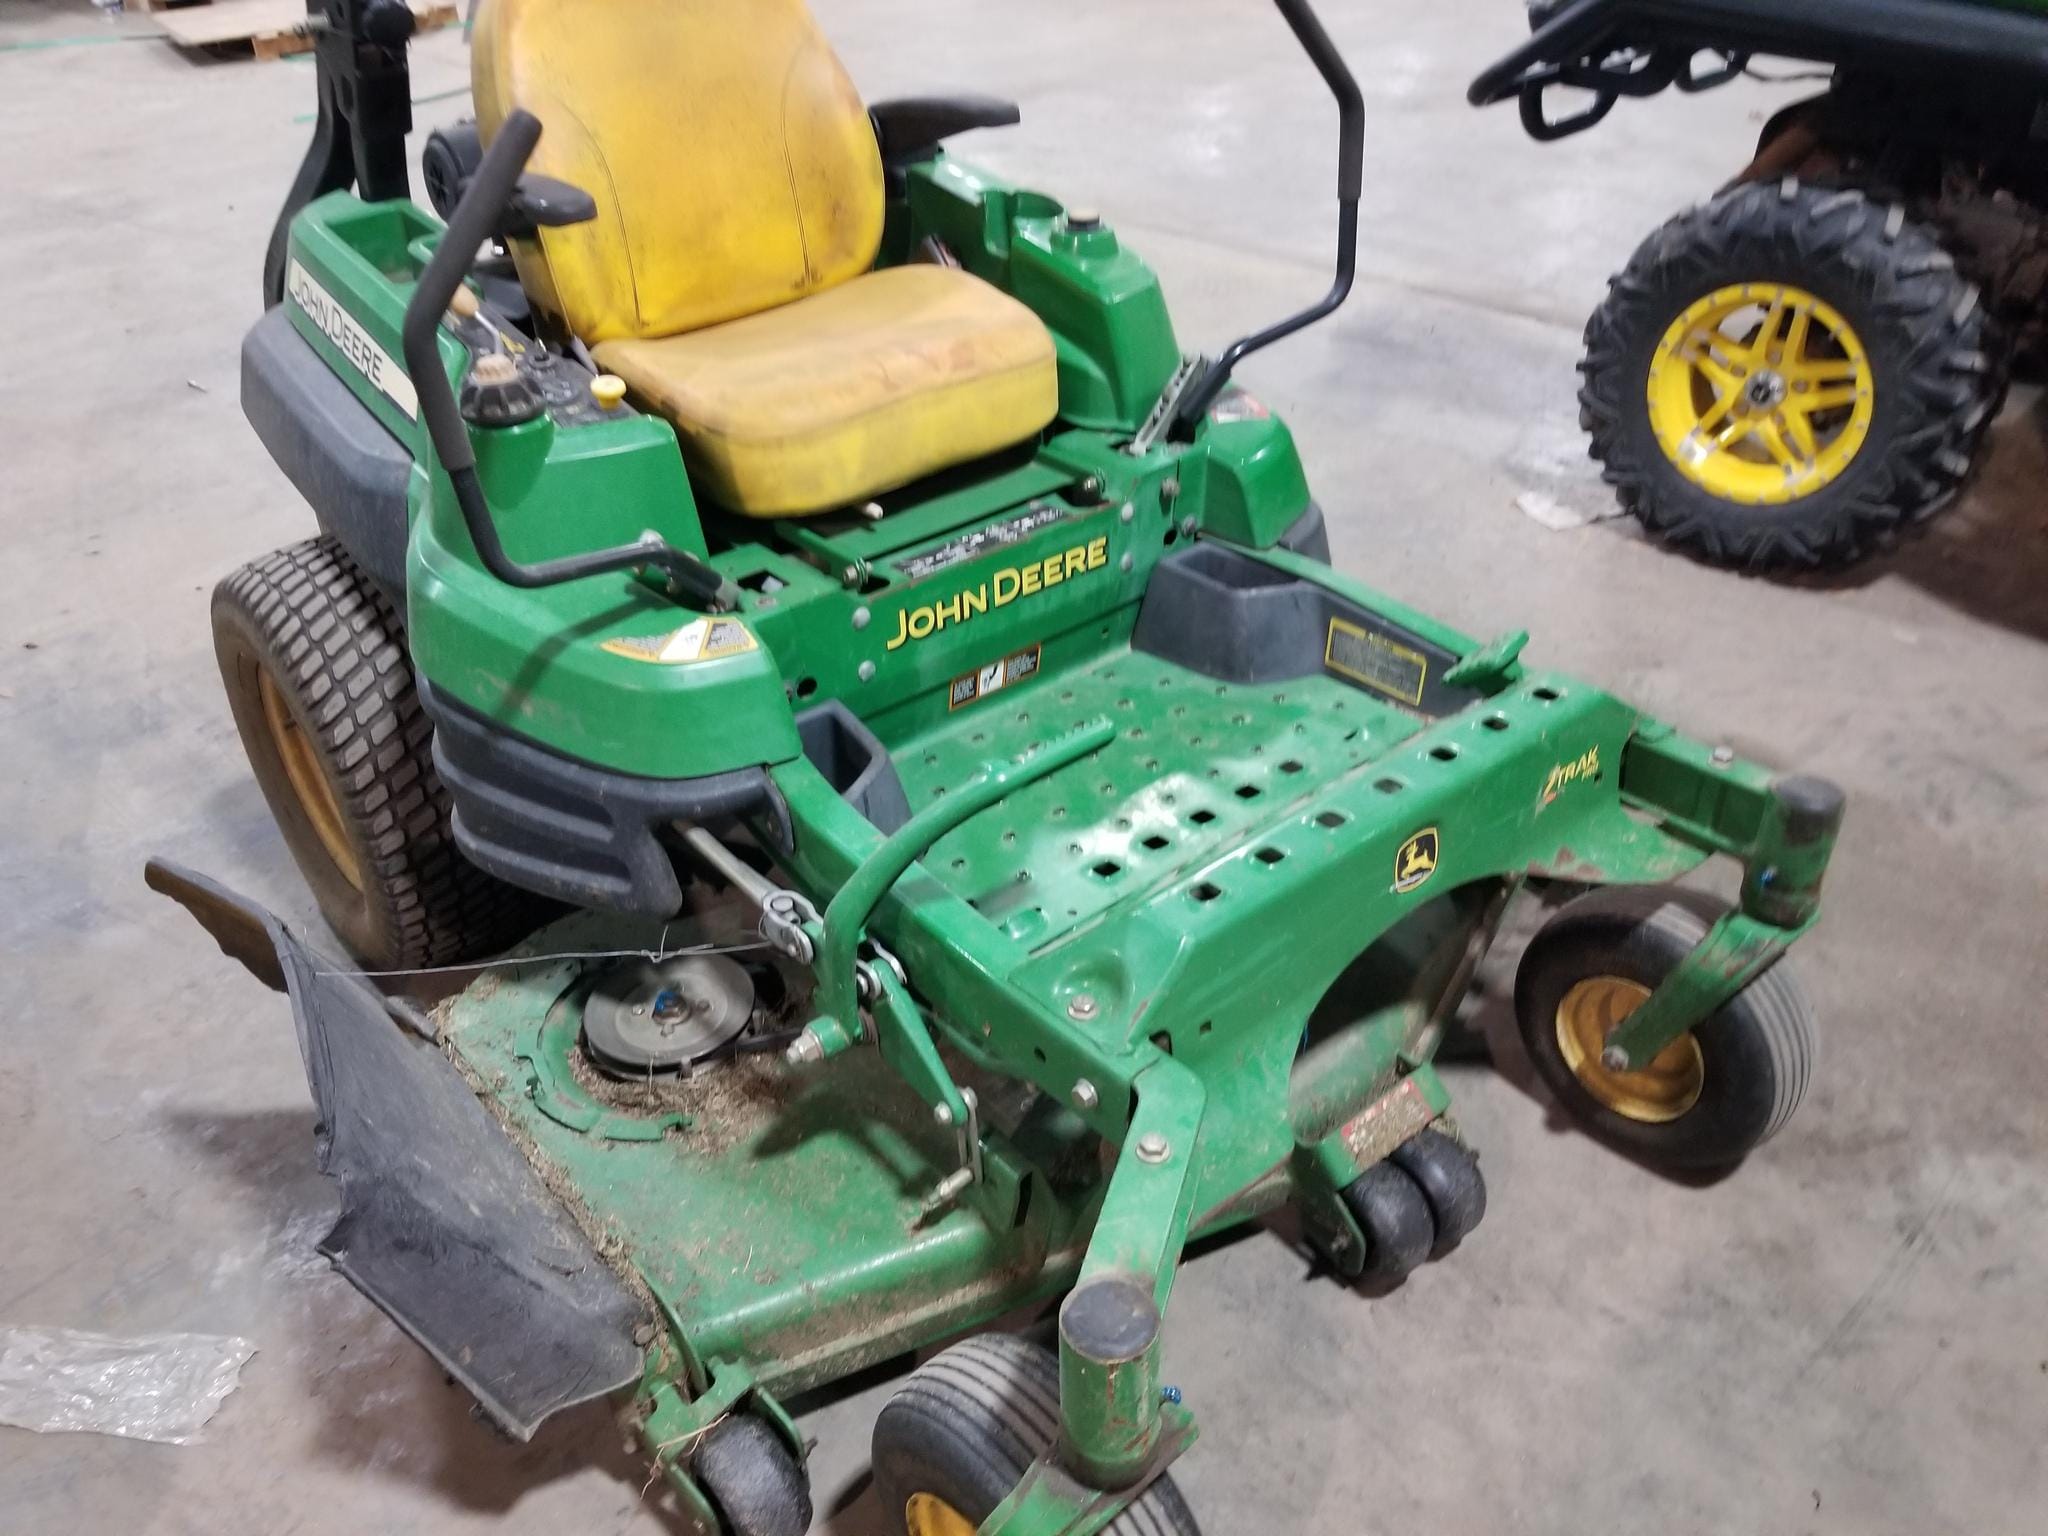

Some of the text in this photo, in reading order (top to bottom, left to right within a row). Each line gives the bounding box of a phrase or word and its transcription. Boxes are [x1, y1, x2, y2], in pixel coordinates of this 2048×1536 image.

[294, 269, 383, 384] JOHN DEERE
[886, 583, 988, 651] JOHN
[993, 536, 1108, 608] DEERE
